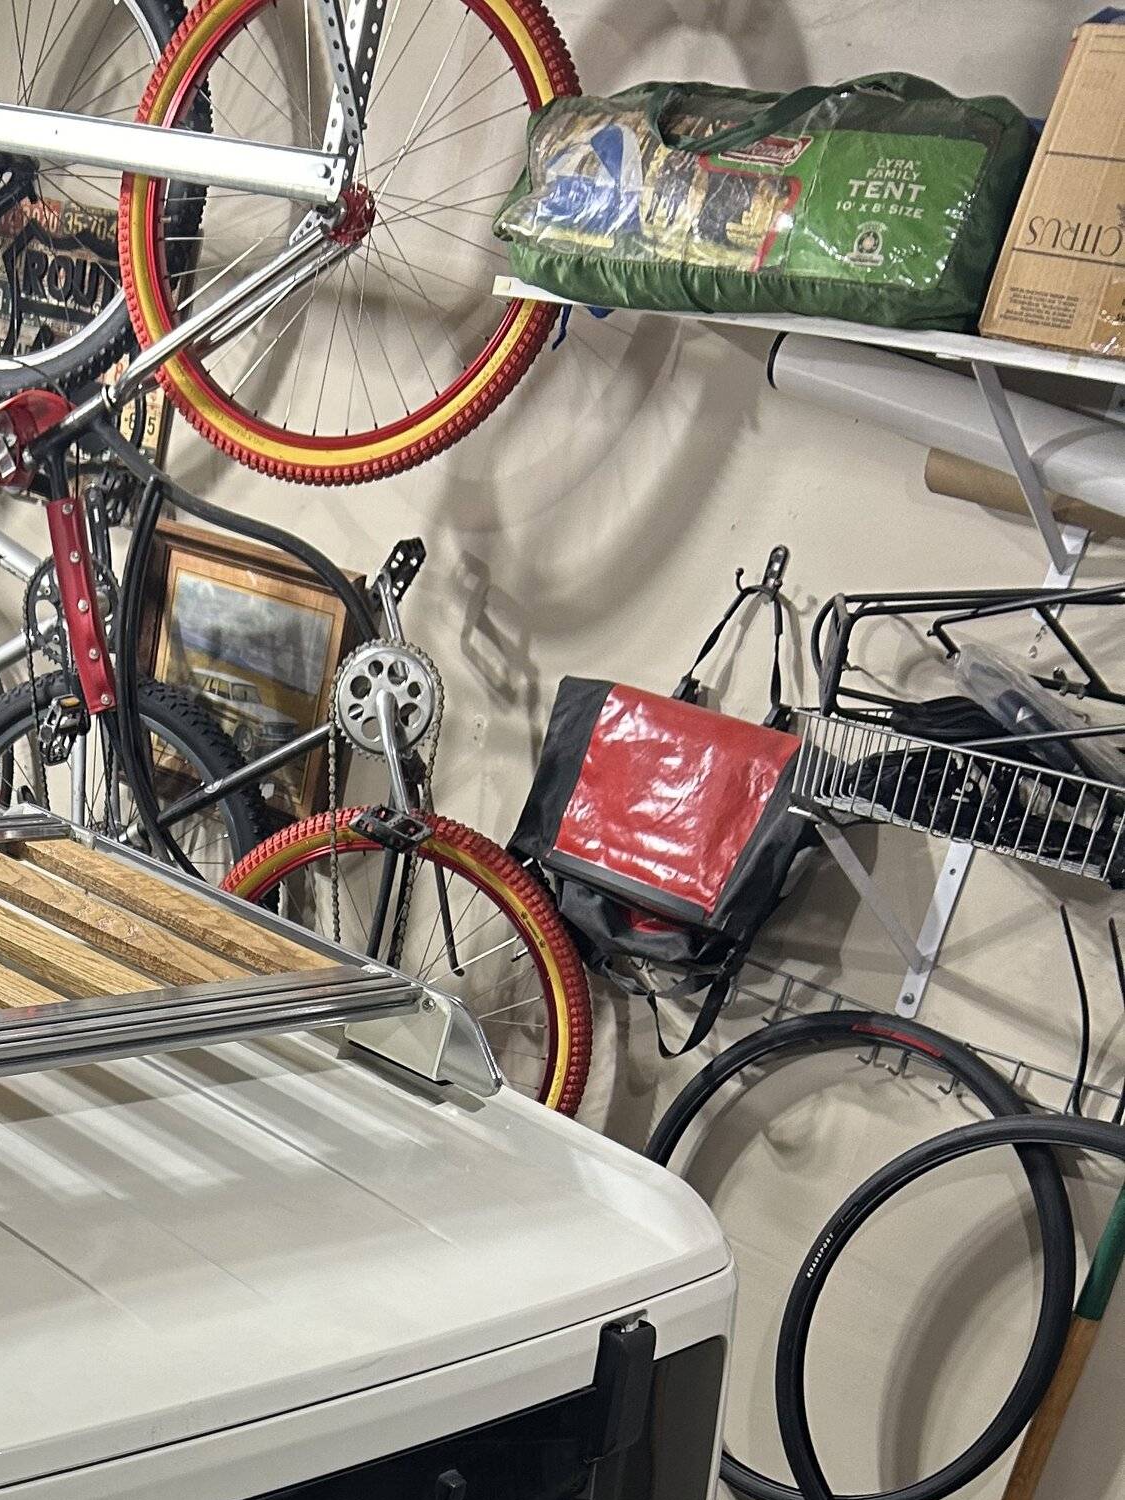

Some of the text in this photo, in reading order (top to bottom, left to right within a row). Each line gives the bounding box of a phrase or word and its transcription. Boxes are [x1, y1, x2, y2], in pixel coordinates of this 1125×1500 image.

[866, 168, 921, 180] FAMILY
[848, 179, 927, 203] TENT
[836, 201, 856, 211] 10'
[888, 203, 925, 219] SIZE
[1026, 215, 1123, 257] CITRUS
